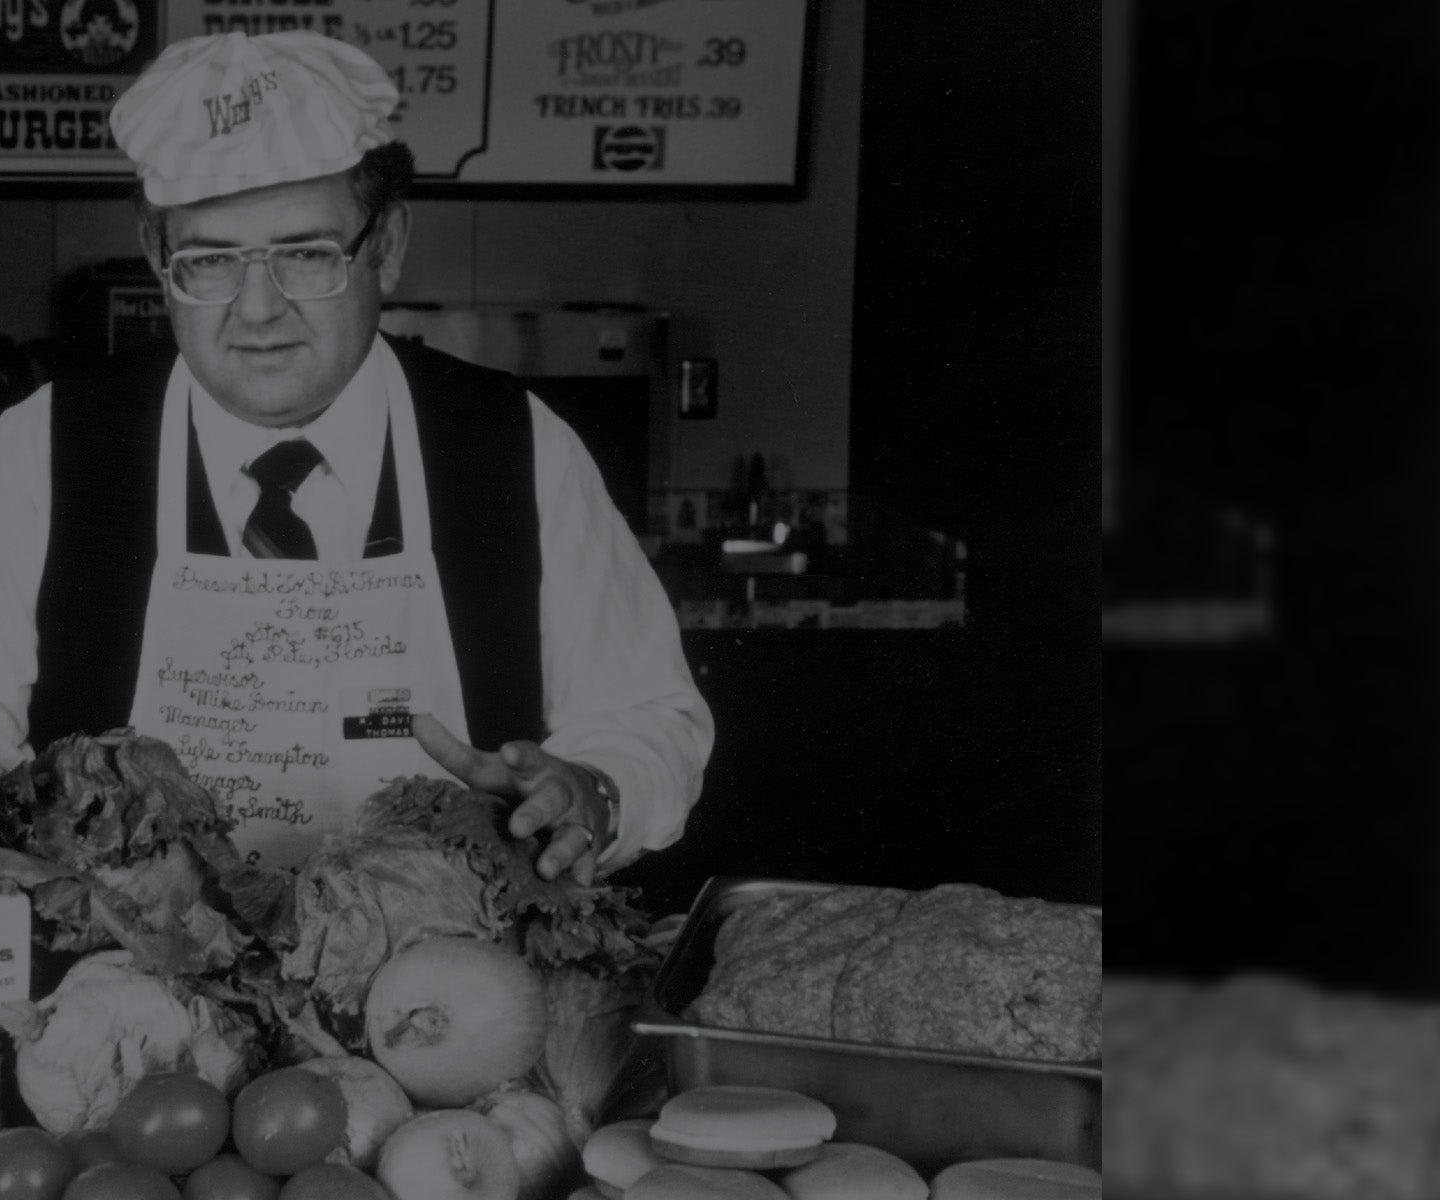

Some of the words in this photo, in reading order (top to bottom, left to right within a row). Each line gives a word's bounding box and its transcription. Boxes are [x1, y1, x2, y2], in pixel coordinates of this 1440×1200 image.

[696, 36, 747, 68] .39
[534, 94, 627, 120] FRENCH
[633, 94, 702, 120] FRIES
[705, 97, 744, 120] .39
[172, 565, 274, 594] Presented
[275, 597, 340, 621] From
[158, 657, 265, 693] Supervisor
[160, 704, 257, 748] Manager
[366, 727, 410, 738] THOMAS
[188, 772, 262, 800] anager
[238, 796, 313, 828] Smith
